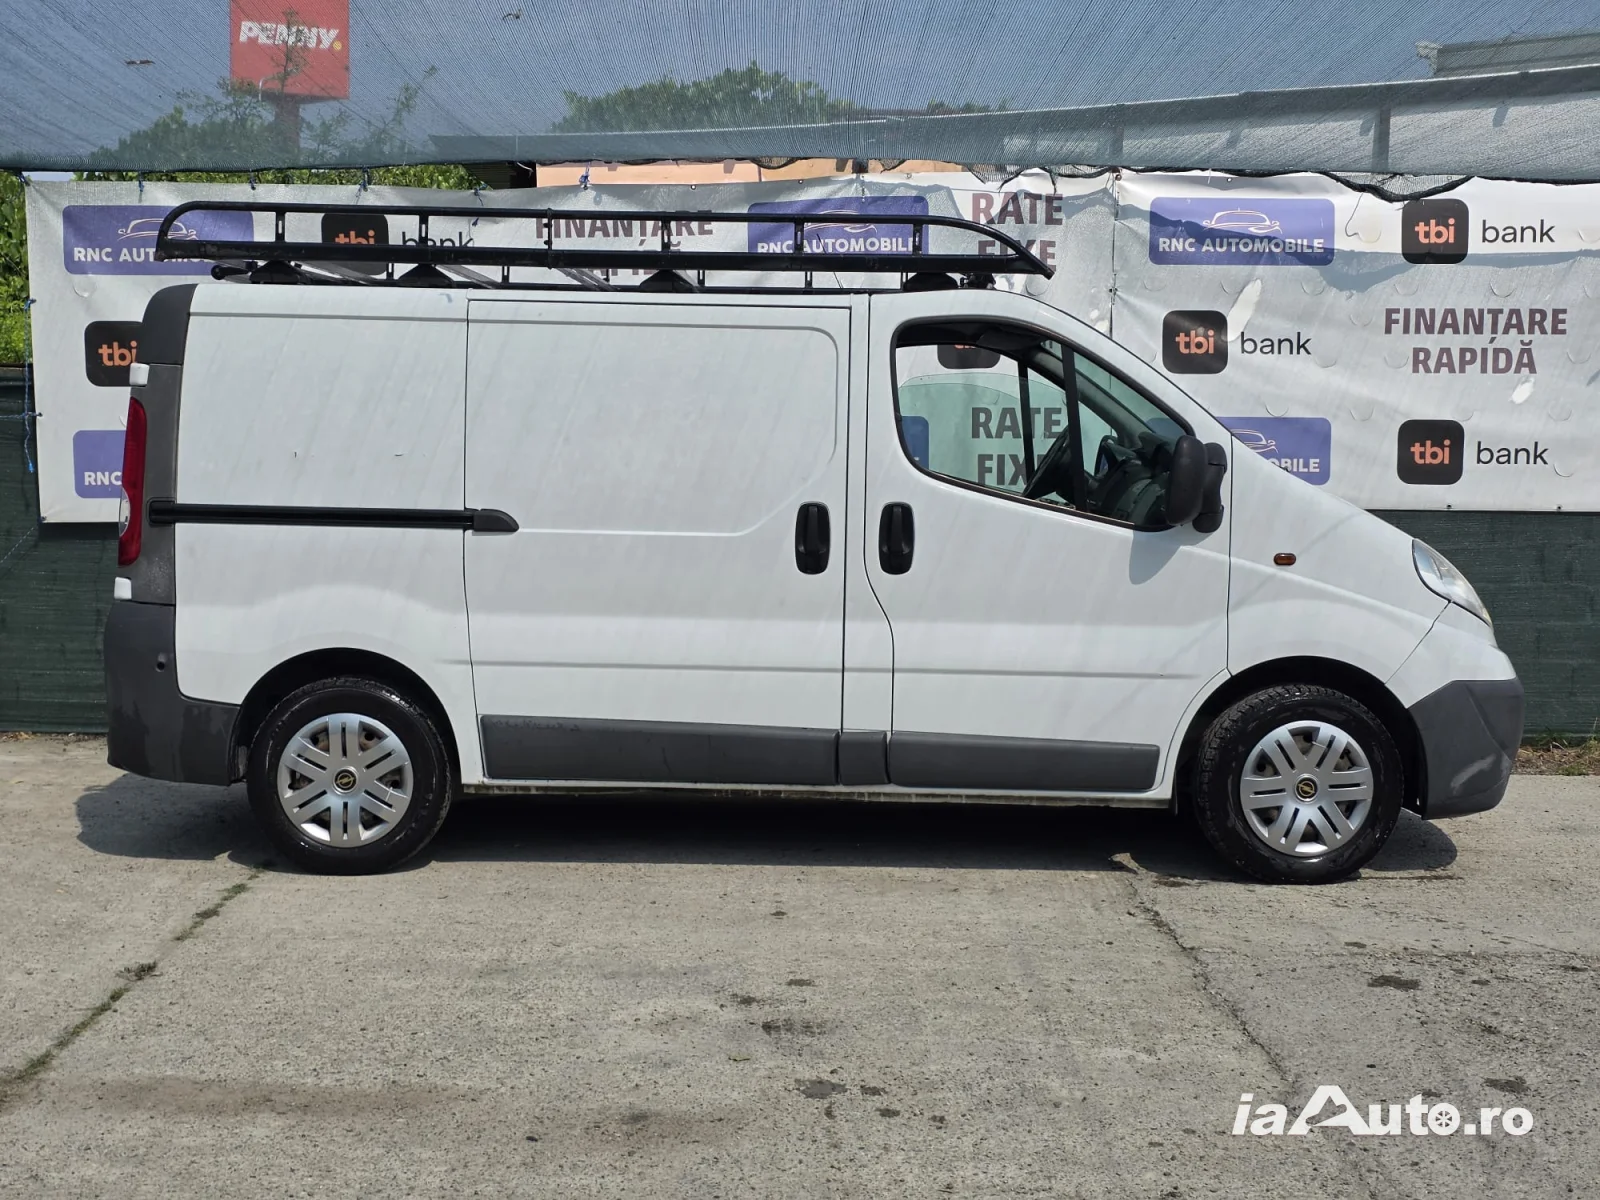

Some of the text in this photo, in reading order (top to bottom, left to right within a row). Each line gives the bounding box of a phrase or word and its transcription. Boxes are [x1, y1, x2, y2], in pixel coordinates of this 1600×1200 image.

[972, 192, 1063, 225] RATE
[1415, 218, 1555, 244] tbi bank
[74, 248, 113, 262] RNC
[1159, 238, 1324, 253] RNC AUTOMOBILE
[98, 341, 138, 367] tbi
[1176, 329, 1311, 355] tbi bank
[1410, 439, 1548, 465] tbi bank
[84, 471, 122, 486] RNC
